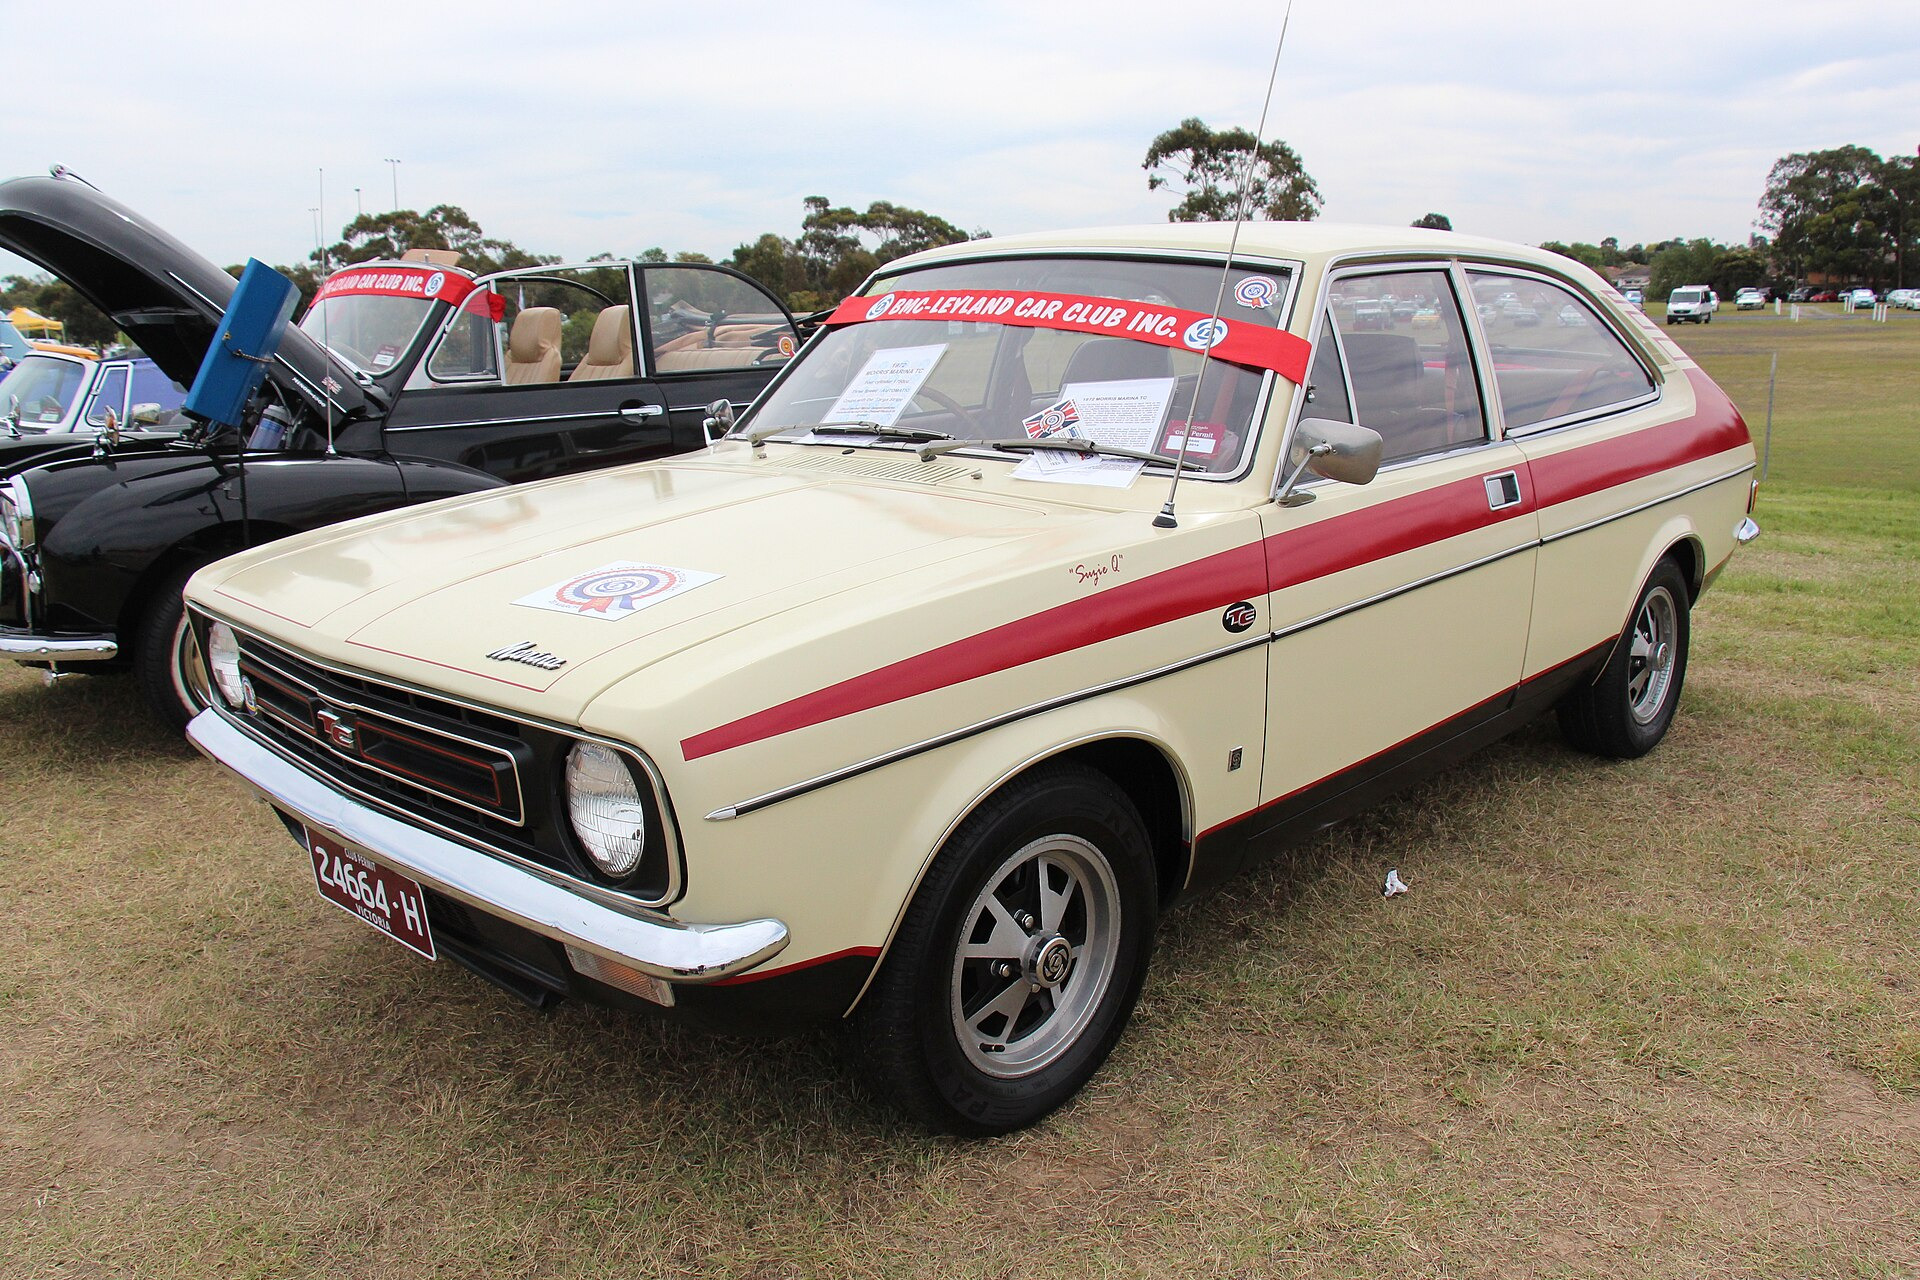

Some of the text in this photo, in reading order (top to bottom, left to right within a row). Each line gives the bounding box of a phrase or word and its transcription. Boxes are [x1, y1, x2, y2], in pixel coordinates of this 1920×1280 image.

[357, 274, 377, 290] CAR
[374, 272, 404, 290] CLUB
[400, 274, 424, 293] INC.
[888, 295, 1178, 338] BMC-LEYLAND CAR CLUB INC.
[1191, 430, 1214, 439] Permit
[354, 903, 392, 933] VICTORIA
